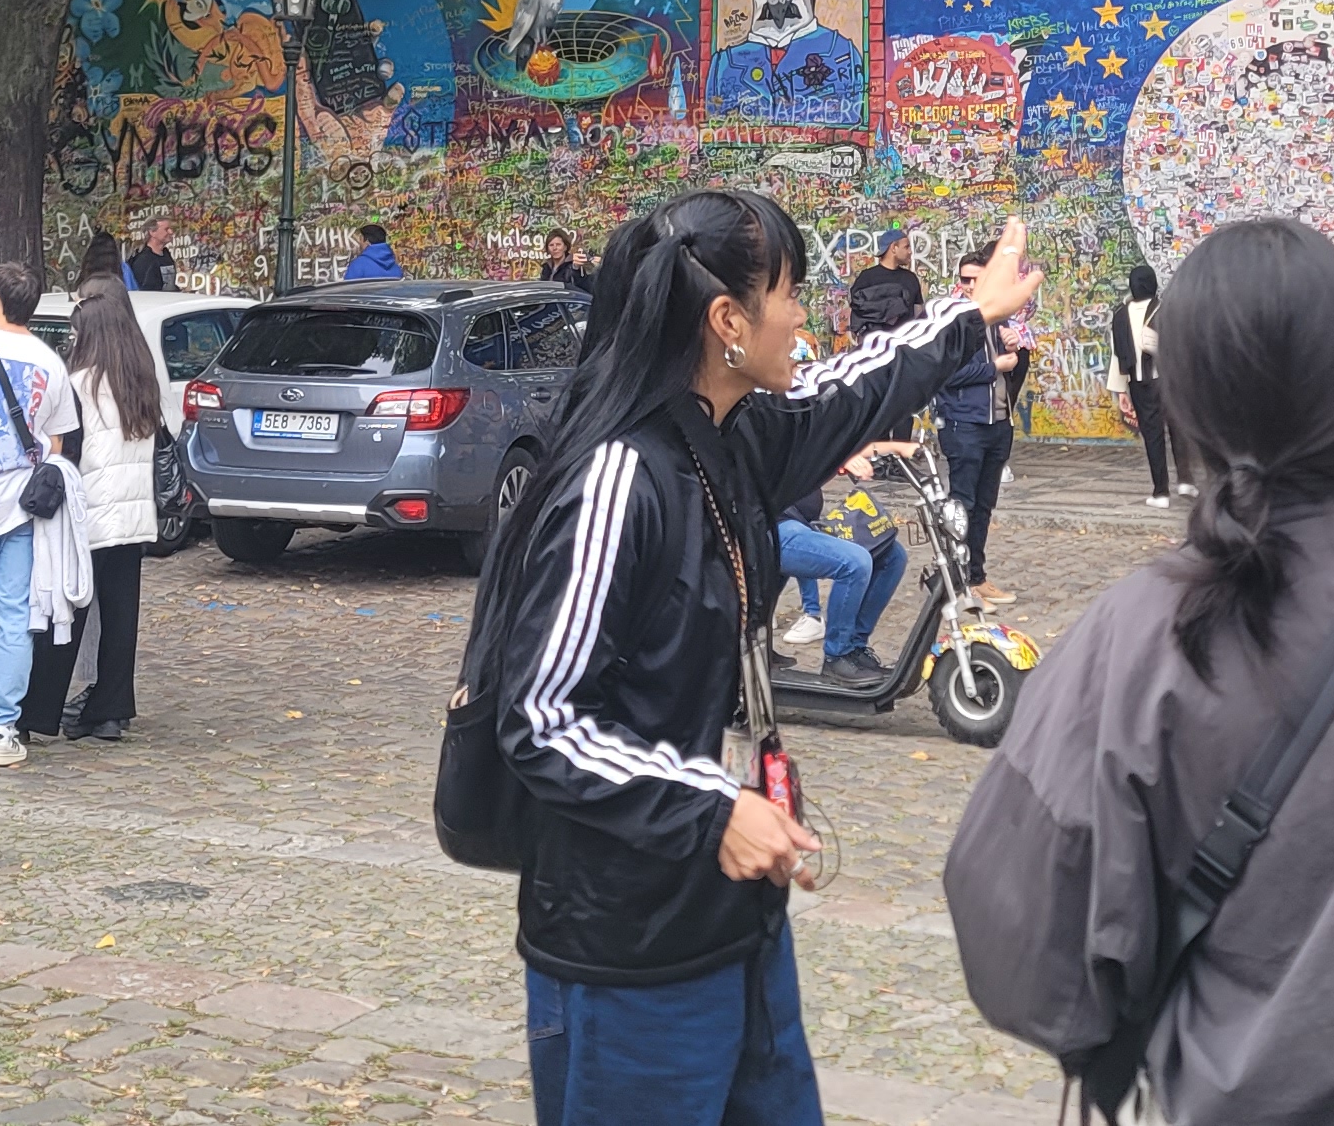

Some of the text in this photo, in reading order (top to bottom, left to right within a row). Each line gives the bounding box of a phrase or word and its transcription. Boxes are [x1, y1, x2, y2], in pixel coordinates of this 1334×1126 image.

[487, 227, 547, 251] Málag
[264, 413, 332, 432] 5E8 7363
